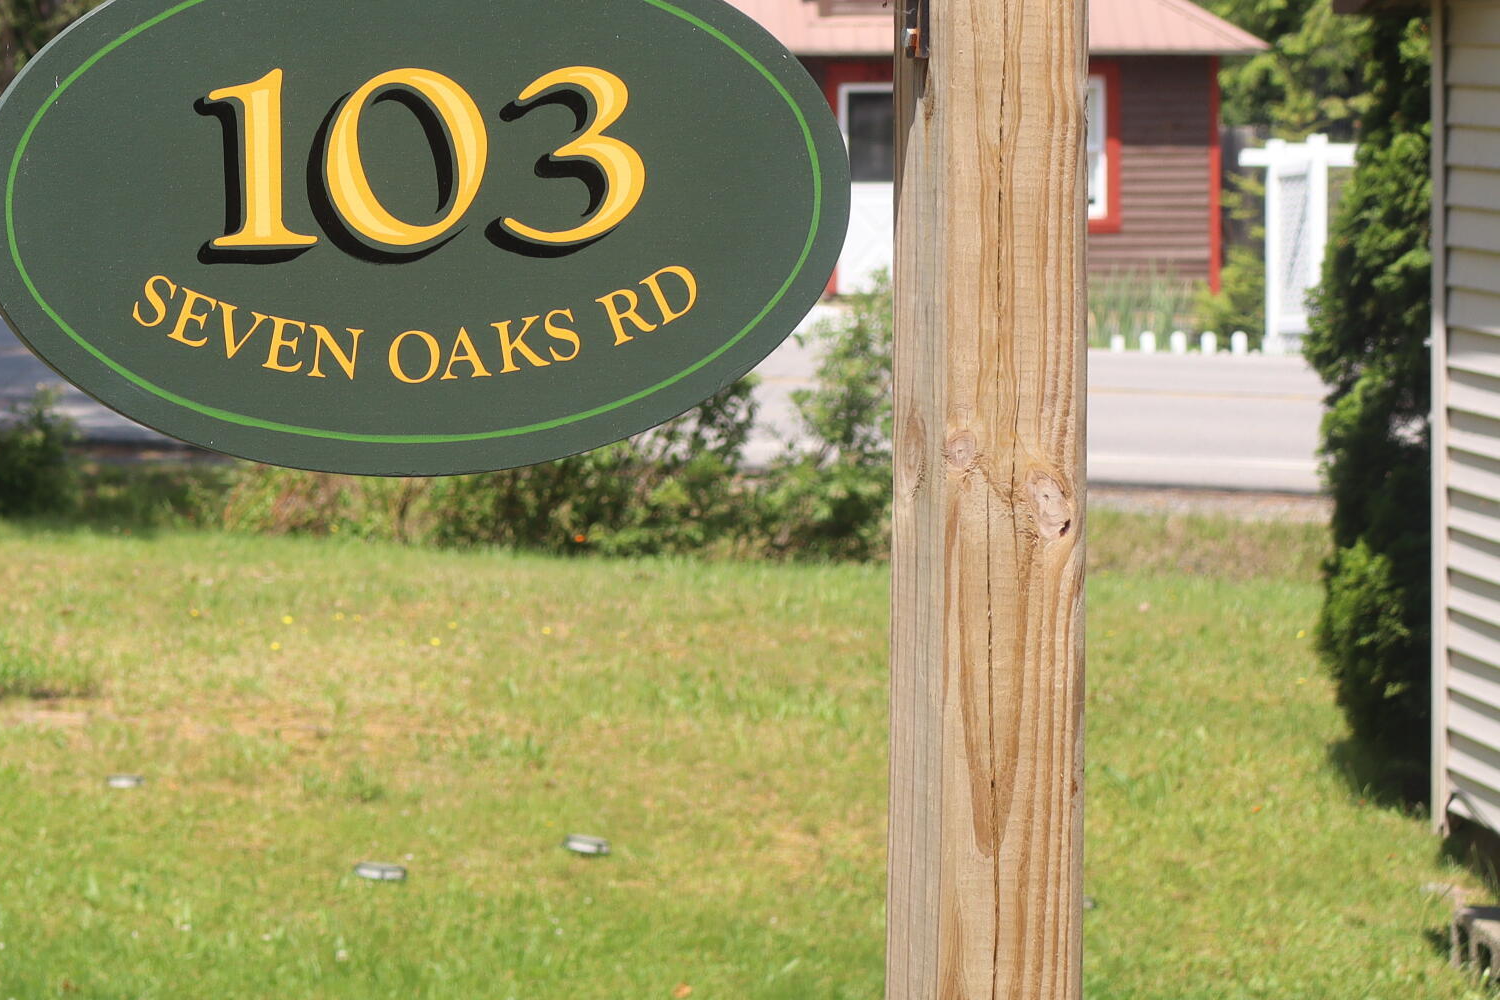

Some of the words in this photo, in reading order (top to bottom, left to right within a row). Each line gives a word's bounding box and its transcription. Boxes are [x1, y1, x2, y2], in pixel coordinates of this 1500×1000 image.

[206, 65, 647, 248] 103
[131, 273, 366, 381] SEVEN
[387, 307, 582, 385] OAKS
[594, 264, 698, 348] RD
